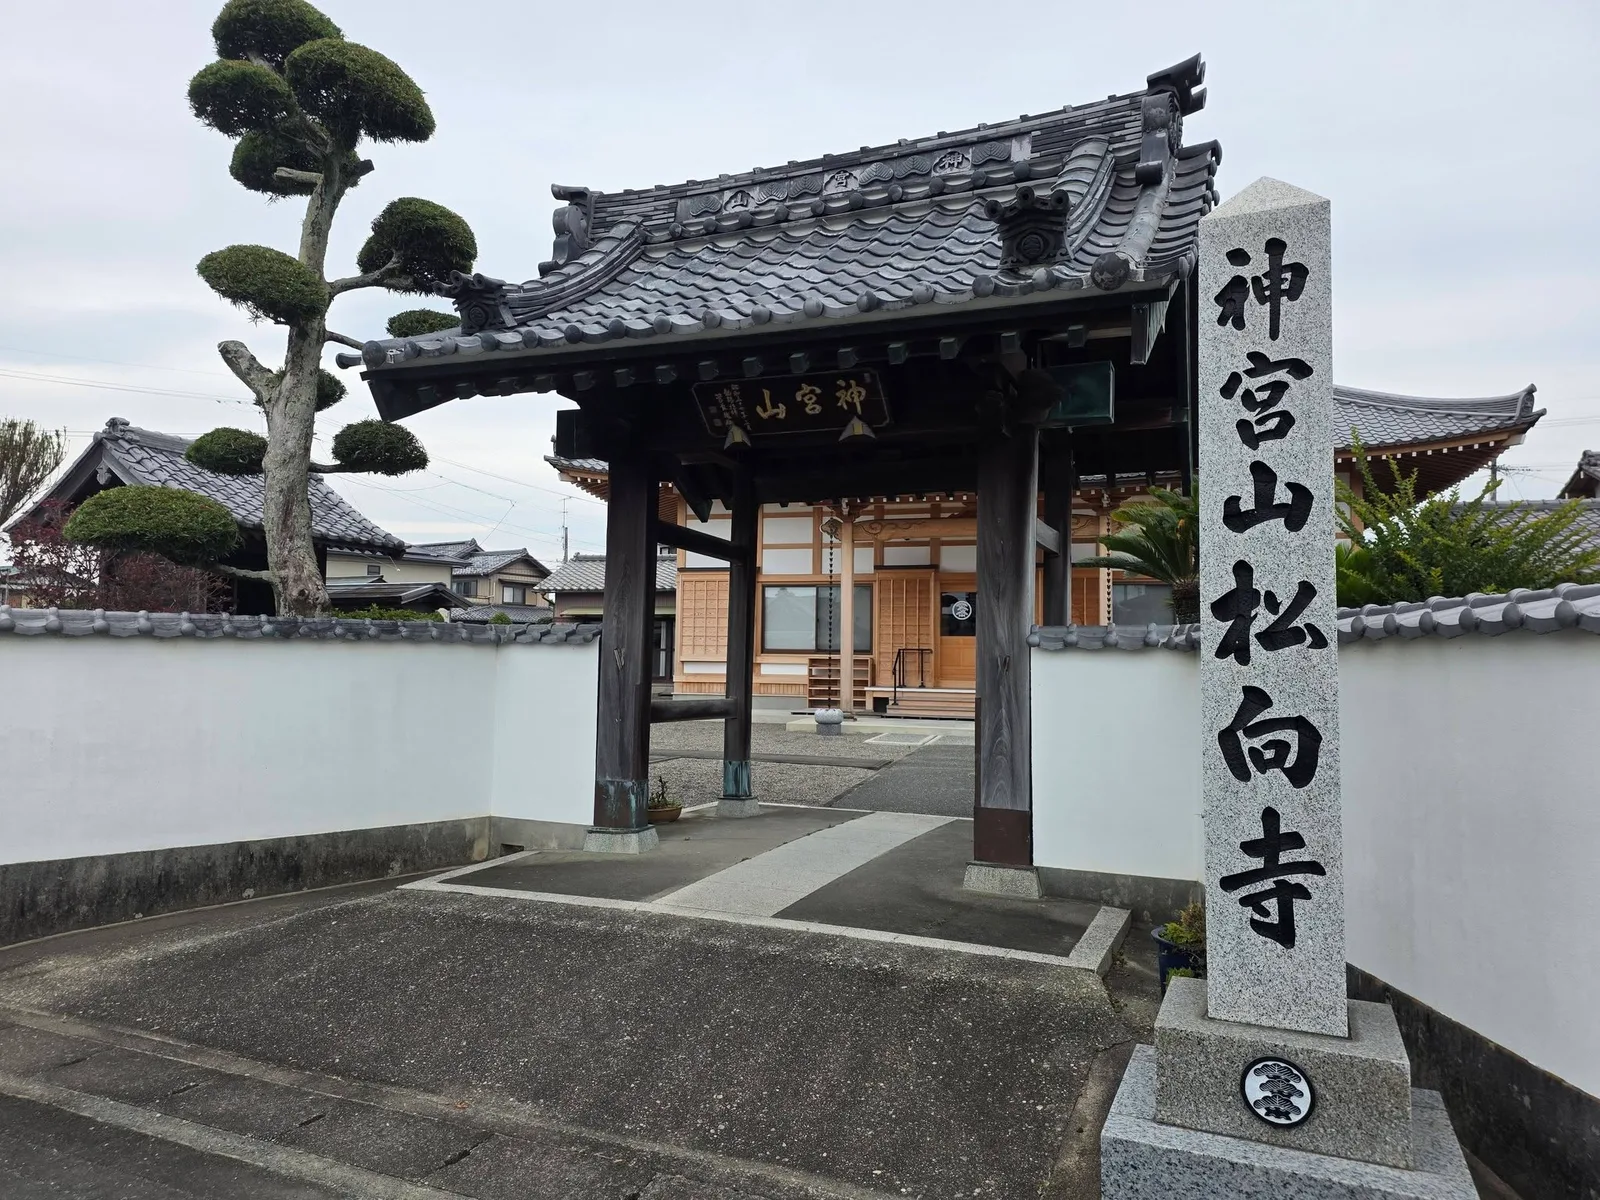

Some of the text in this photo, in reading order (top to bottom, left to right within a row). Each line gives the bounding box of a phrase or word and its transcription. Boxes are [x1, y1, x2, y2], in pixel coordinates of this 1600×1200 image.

[939, 152, 963, 169] 神
[731, 192, 749, 209] 山
[1210, 236, 1328, 949] 神宮山松向寺
